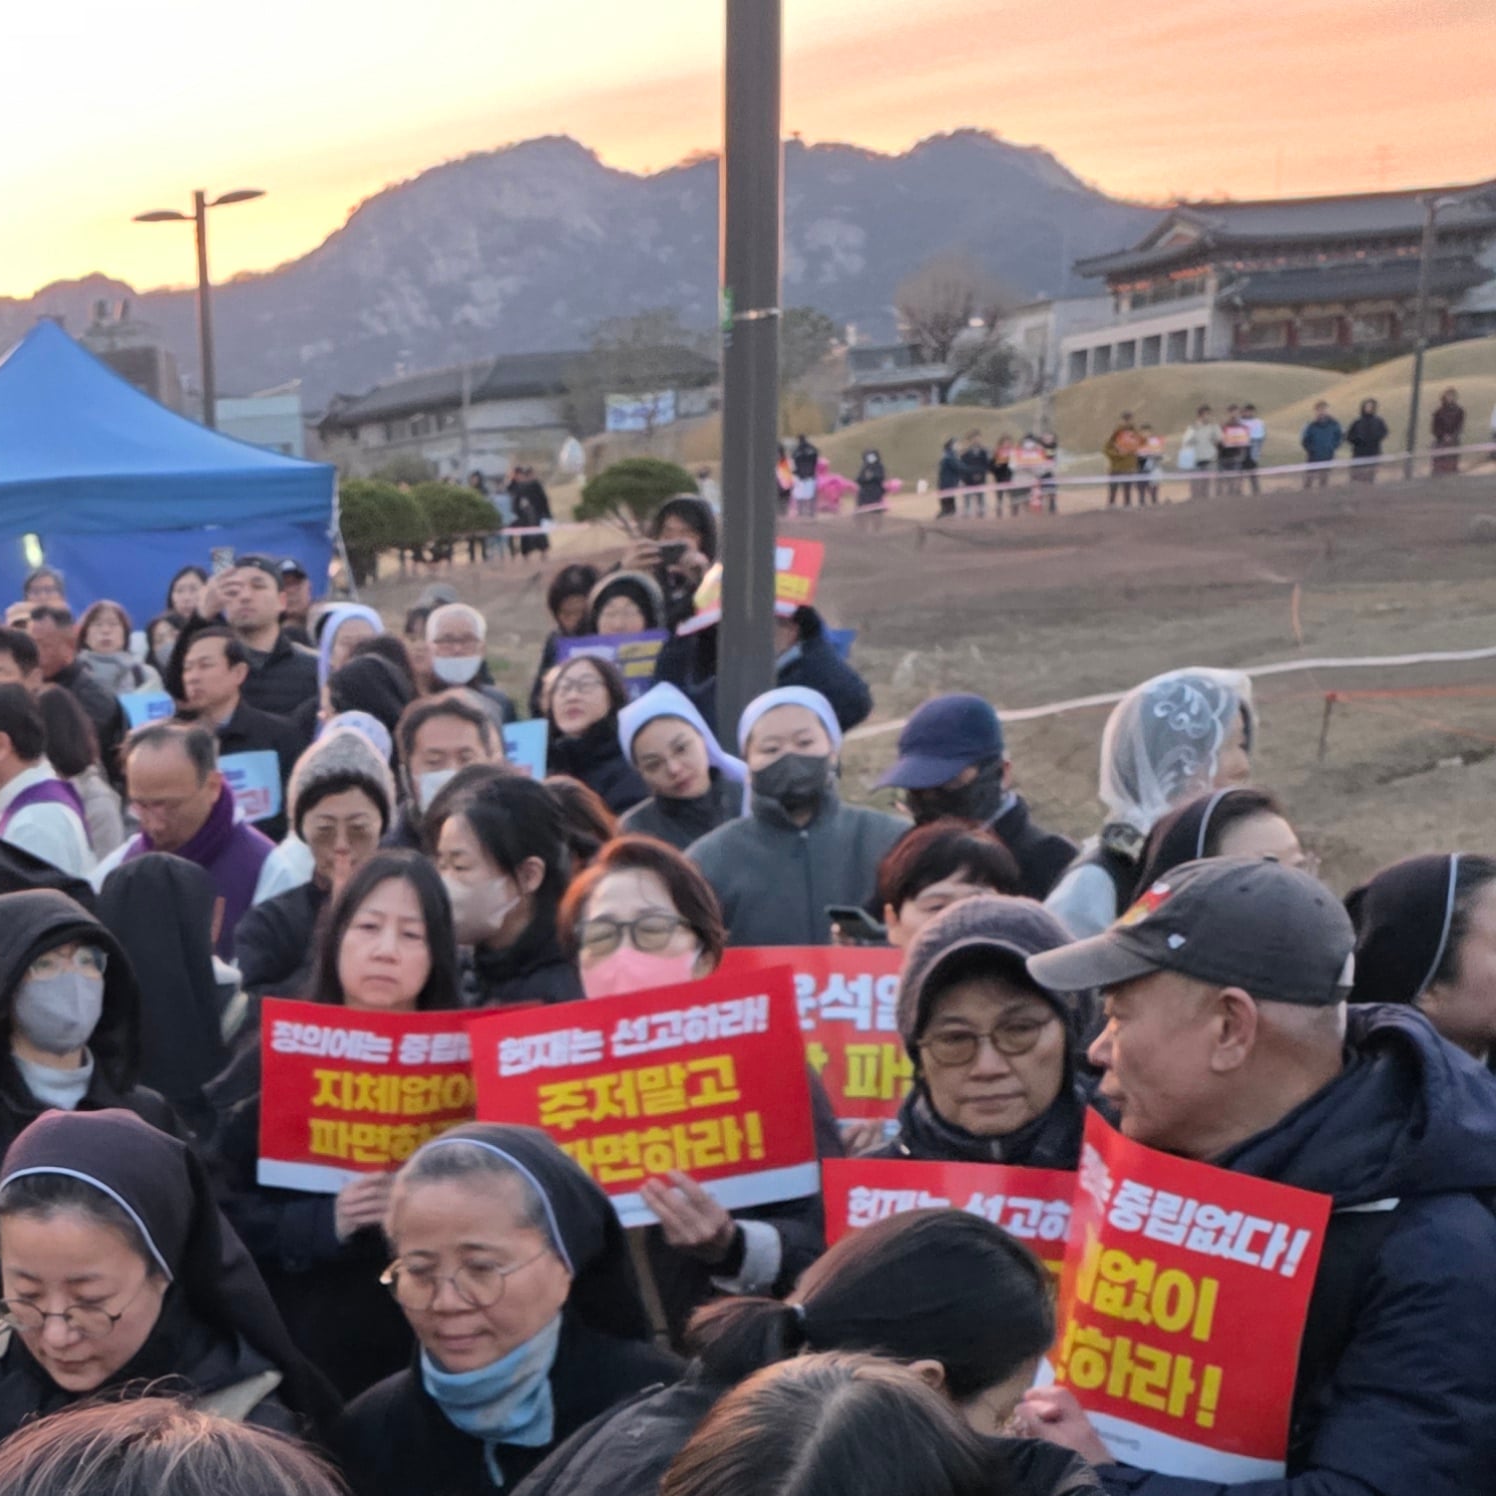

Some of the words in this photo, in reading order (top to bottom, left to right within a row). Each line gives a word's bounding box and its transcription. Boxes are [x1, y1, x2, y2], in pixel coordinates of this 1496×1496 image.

[271, 1020, 392, 1064] 정의에는
[397, 1031, 471, 1064] 중립
[611, 995, 770, 1058] 선고하라!
[538, 1054, 740, 1130] 주저말고
[1108, 1179, 1311, 1278] 중립없다!
[1054, 1318, 1223, 1428] 하라!
